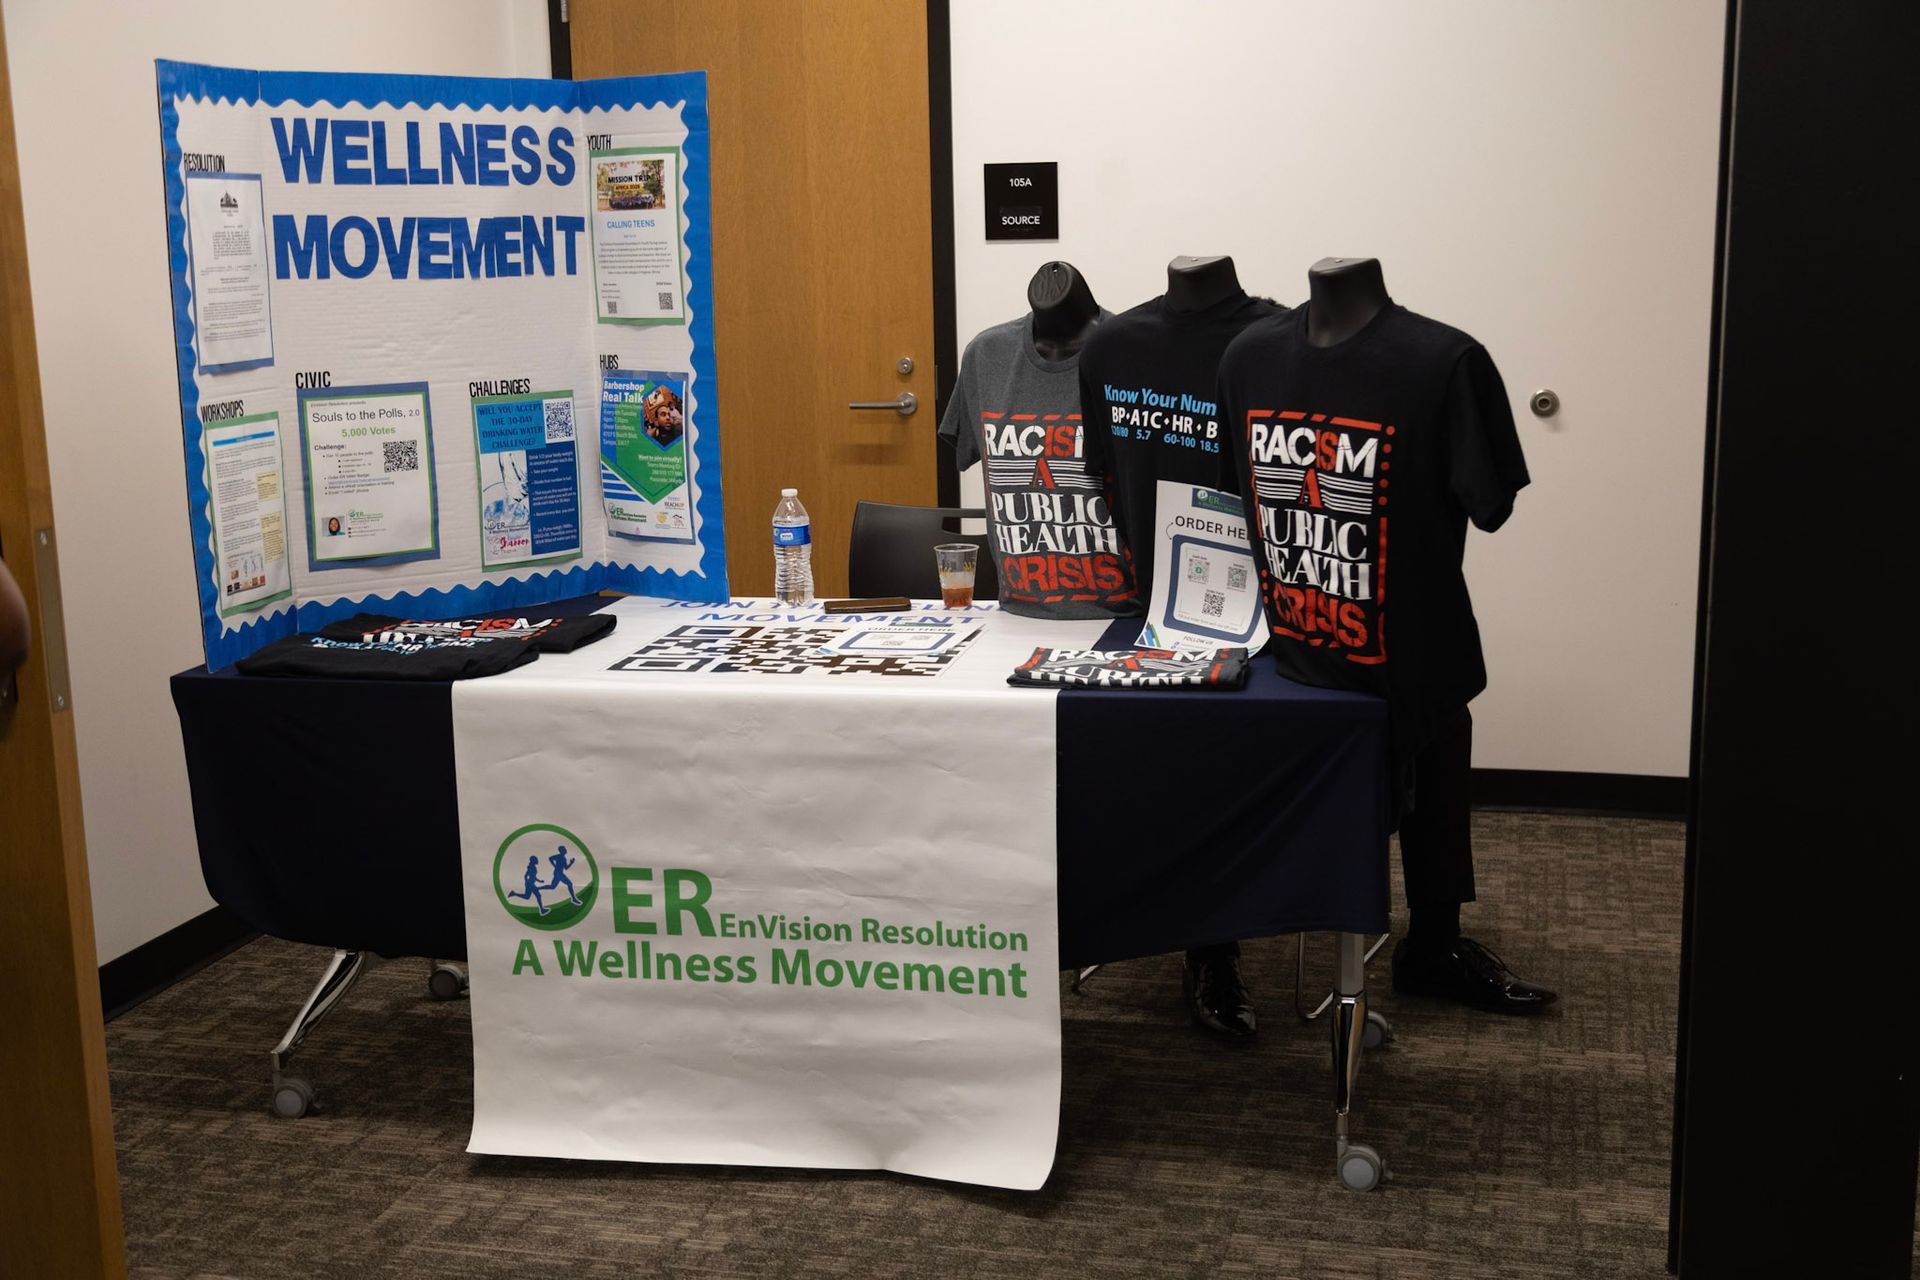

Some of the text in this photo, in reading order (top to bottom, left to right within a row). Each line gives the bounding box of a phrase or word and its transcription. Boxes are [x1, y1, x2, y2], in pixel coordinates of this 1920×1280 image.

[270, 117, 576, 187] WELLNESS
[586, 134, 612, 150] YOUTH
[184, 152, 225, 172] RESOLUTION
[608, 175, 632, 184] MISSION
[1009, 178, 1032, 187] 105A
[607, 220, 656, 228] CALLING TEENS
[1002, 216, 1040, 225] SOURCE
[272, 214, 586, 280] MOVEMENT
[600, 354, 618, 370] HUBS
[296, 371, 331, 389] CIVIC
[470, 378, 530, 398] CHALLENGES
[604, 381, 644, 394] Barbershop
[603, 391, 644, 404] Real Talk
[1104, 384, 1138, 404] Know
[1142, 388, 1178, 408] Your
[201, 400, 244, 424] WORKSHOPS
[312, 408, 420, 423] Souls to the Polls, 2.0
[479, 407, 496, 416] WILL
[516, 404, 542, 412] ACCEPT
[508, 416, 532, 425] 30-DAY
[342, 426, 396, 438] 5,000 Votes
[482, 426, 542, 438] DRINKING WATER
[1136, 430, 1152, 440] 5.7
[1164, 433, 1196, 448] 60-100
[1200, 440, 1220, 454] 18.5
[492, 438, 536, 449] CHALLENGE?
[1251, 423, 1379, 478] RACISM
[1032, 457, 1056, 488] A
[1299, 468, 1324, 508] A
[991, 492, 1112, 526] PUBLIC
[1175, 515, 1249, 540] ORDER HE
[1258, 504, 1368, 561] PUBLIC
[994, 524, 1120, 556] HEALTH
[1004, 555, 1124, 592] CRISIS
[1264, 540, 1372, 600] HEALTH
[697, 613, 985, 624] MOVEMENT
[1272, 581, 1368, 648] CRISIS
[311, 636, 364, 648] Know
[1184, 636, 1205, 644] FOLLOW
[610, 866, 717, 937] ER
[720, 913, 1028, 952] EnVision Resolution
[512, 938, 1028, 998] A Wellness Movement
